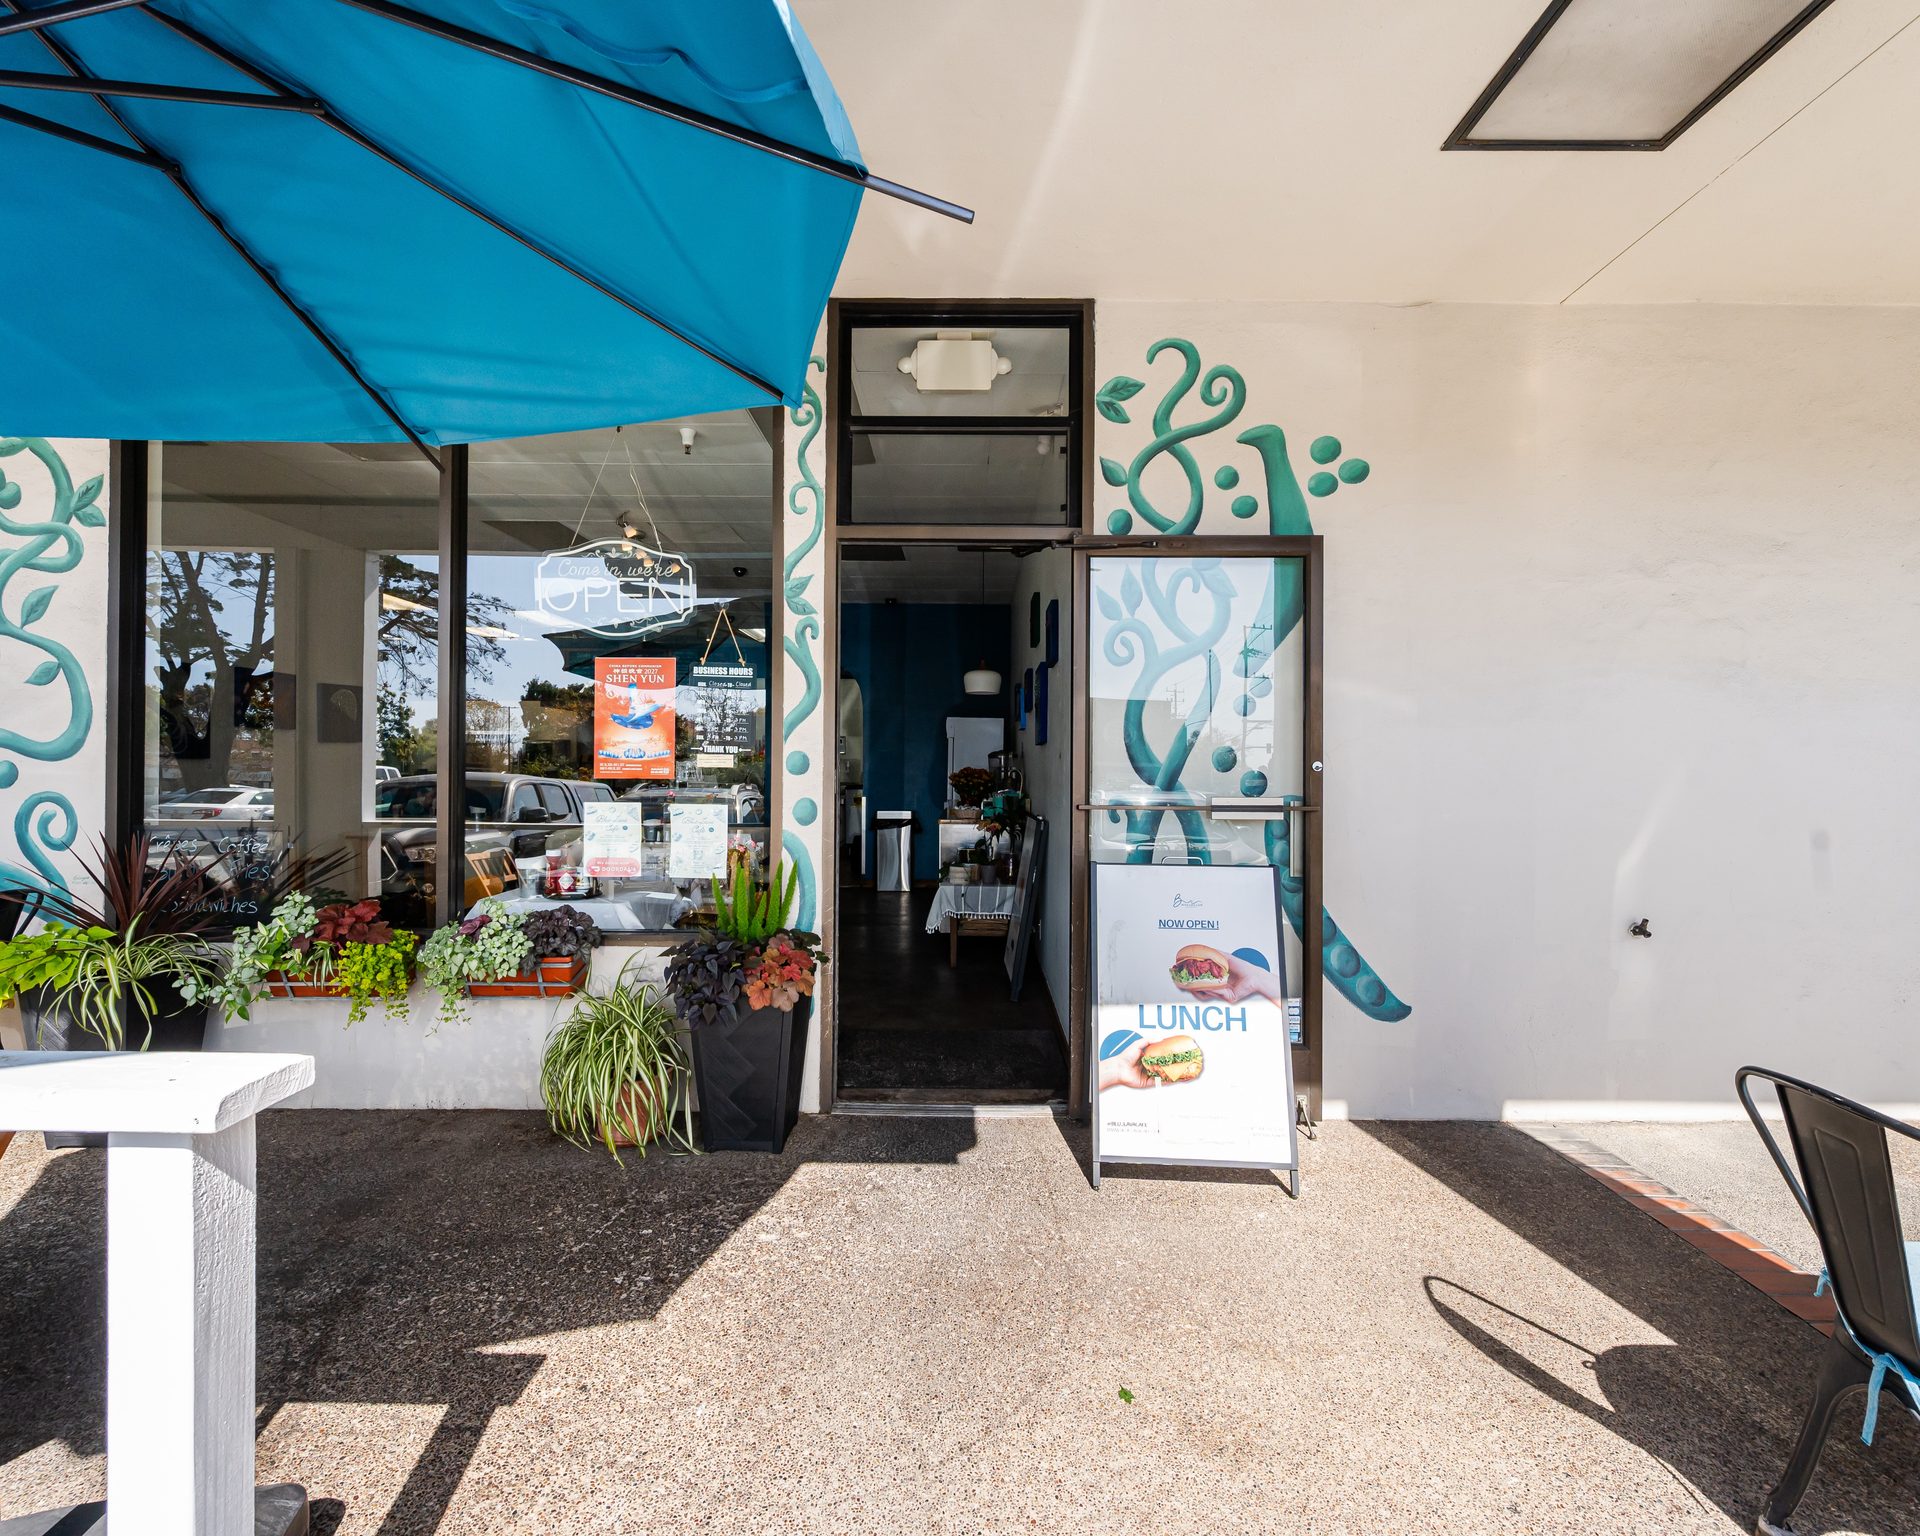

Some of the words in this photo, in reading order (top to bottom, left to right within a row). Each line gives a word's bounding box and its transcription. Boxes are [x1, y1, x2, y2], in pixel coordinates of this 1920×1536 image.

[557, 559, 601, 577] Come
[543, 577, 684, 614] OPEN
[693, 666, 728, 675] BUSINESS
[729, 667, 753, 676] HOURS
[606, 674, 637, 683] SHEN
[640, 674, 665, 683] YUN
[703, 745, 725, 753] THANK
[725, 745, 739, 753] YOU
[218, 836, 270, 854] Coffee
[1158, 919, 1184, 928] NOW
[1138, 1003, 1247, 1032] LUNCH
